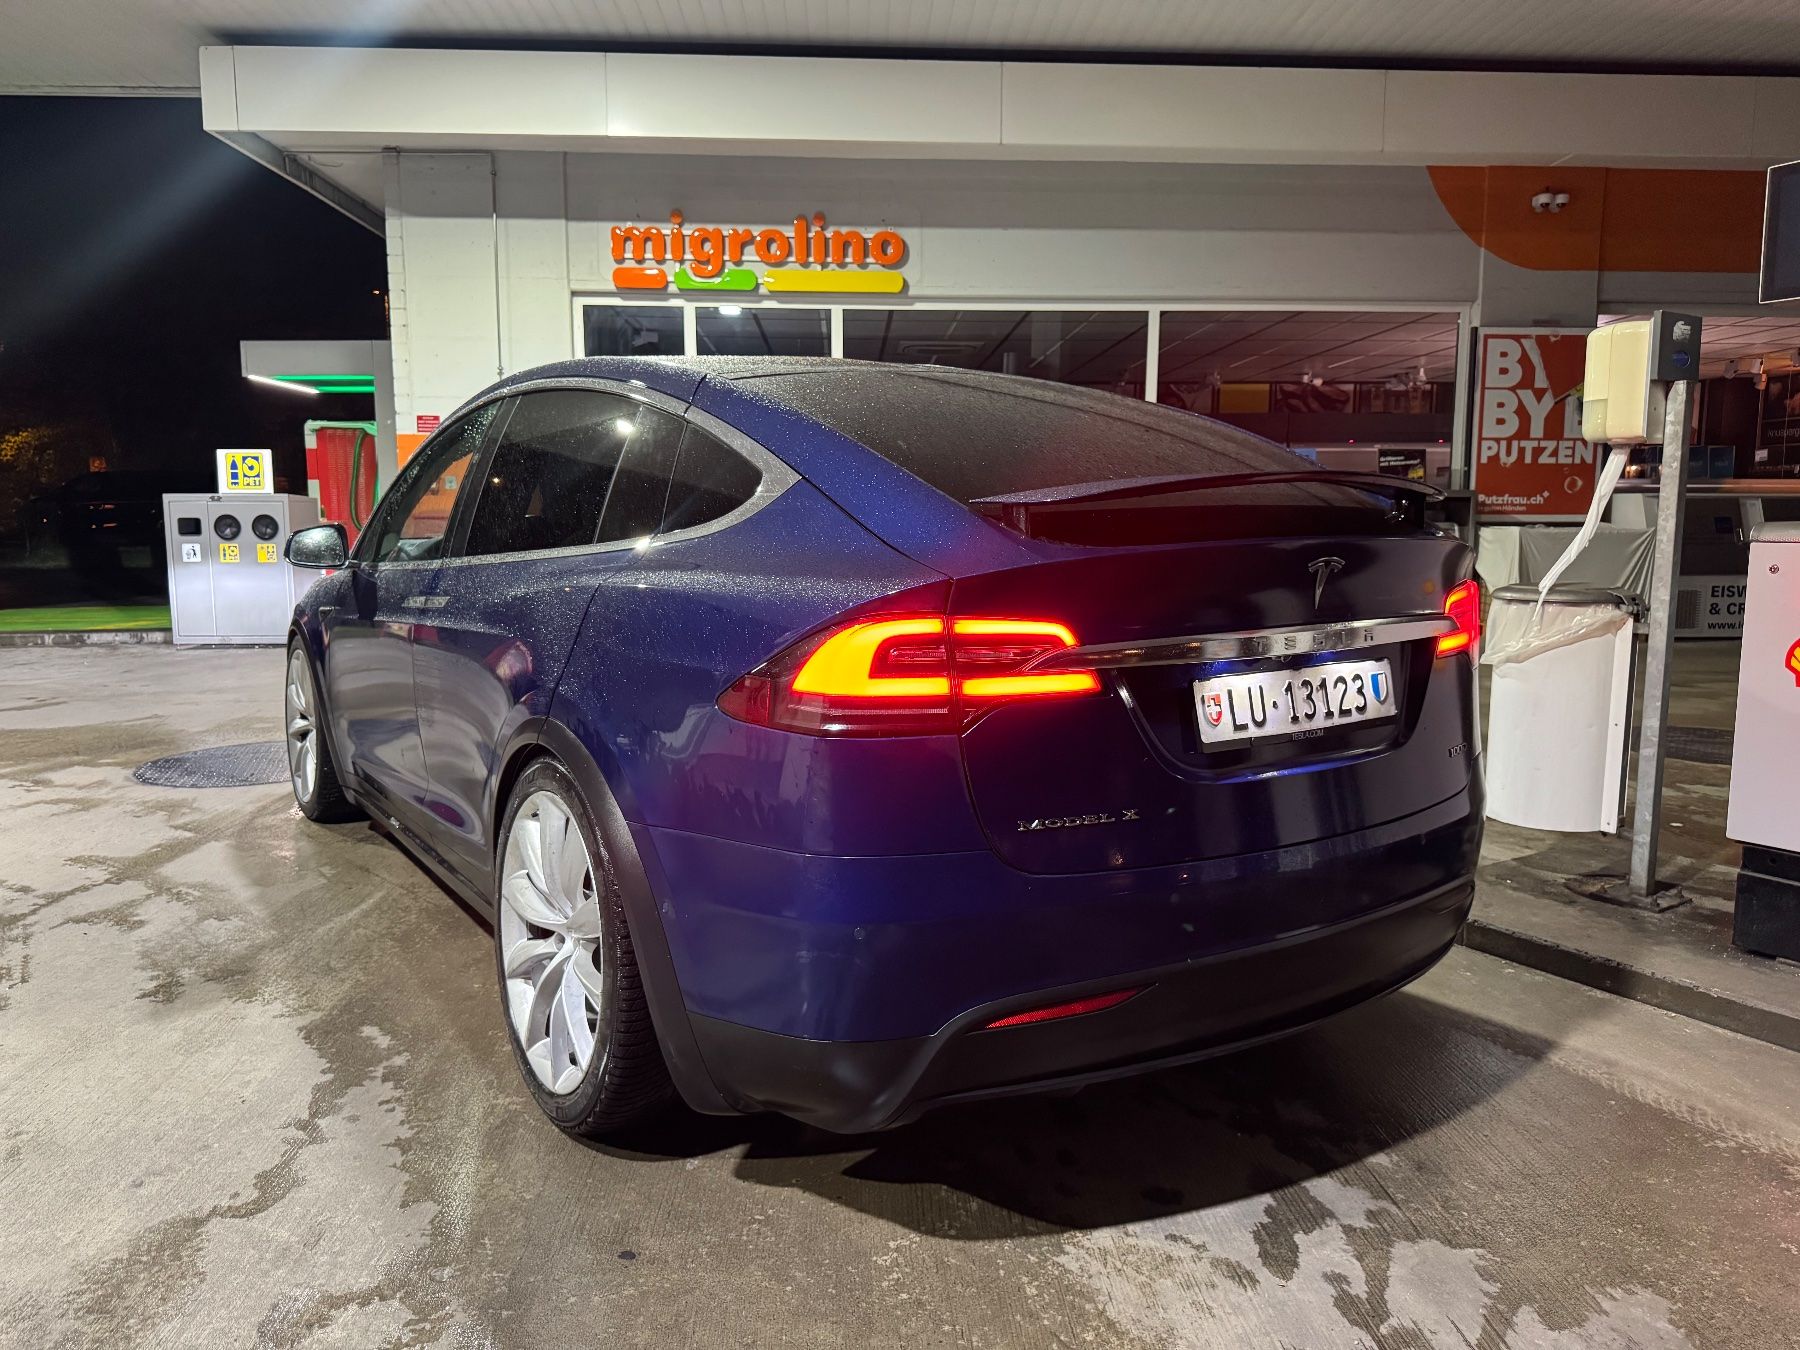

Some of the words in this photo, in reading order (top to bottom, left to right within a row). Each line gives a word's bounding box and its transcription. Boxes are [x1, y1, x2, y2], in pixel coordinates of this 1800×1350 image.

[610, 209, 905, 278] migrolino
[1480, 440, 1594, 465] PUTZEN
[243, 477, 261, 487] PET
[1477, 493, 1544, 505] Putzfrau.ch
[1709, 602, 1721, 615] &
[1017, 813, 1116, 832] MODEL
[1122, 808, 1140, 821] X
